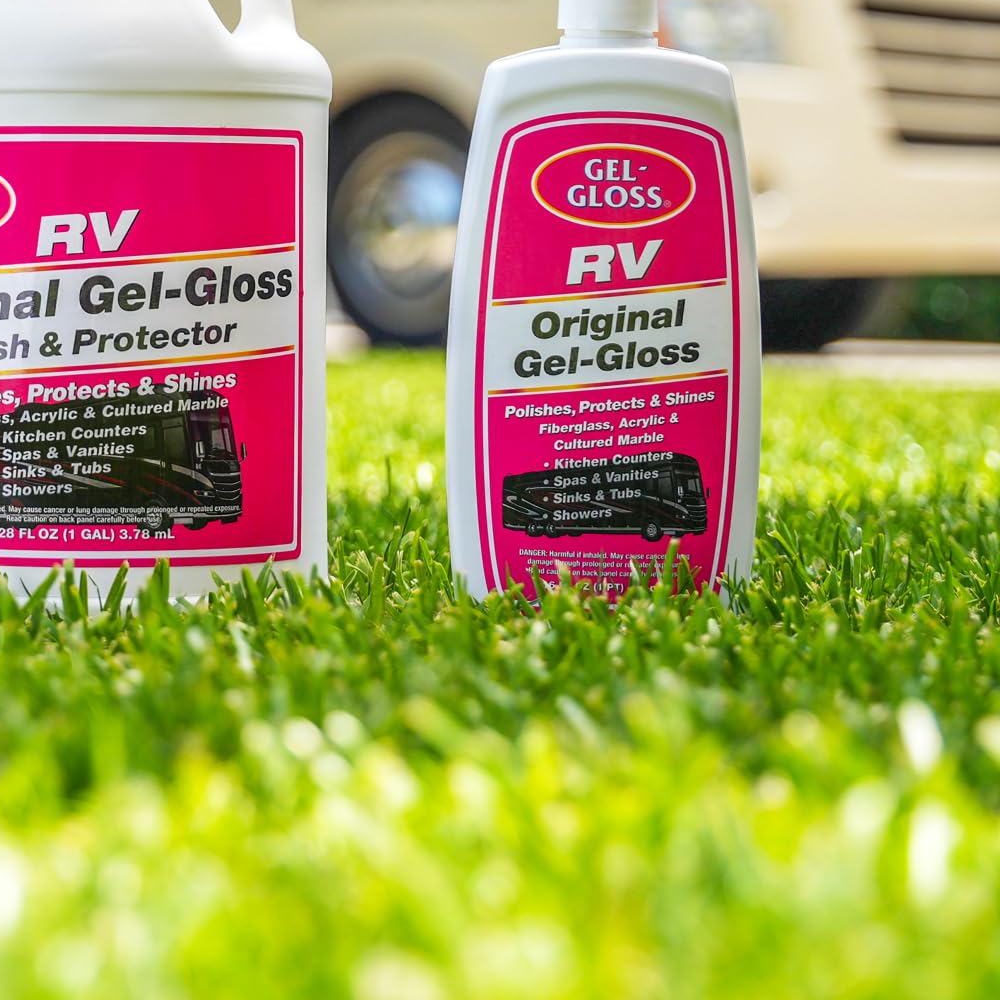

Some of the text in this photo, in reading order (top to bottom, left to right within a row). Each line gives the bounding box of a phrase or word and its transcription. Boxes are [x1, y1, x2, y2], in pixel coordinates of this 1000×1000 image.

[584, 159, 648, 182] GEL-
[35, 209, 141, 257] RV
[566, 239, 664, 286] RV
[79, 265, 293, 315] Gel-Gloss
[531, 299, 686, 341] Original
[39, 331, 63, 357] &
[72, 321, 237, 354] Protector
[514, 341, 700, 378] Gel-Gloss
[27, 379, 130, 404] Protects
[137, 376, 156, 395] &
[163, 371, 237, 393] Shines
[20, 407, 78, 423] Acrylic
[83, 406, 96, 419] &
[102, 401, 173, 418] Cultured
[177, 396, 229, 412] Marble
[505, 390, 715, 418] Polishes, Protects & Shines
[539, 412, 679, 435] Fiberglass, Acrylic &
[2, 424, 147, 444] Kitchen Counters
[554, 432, 664, 451] Cultured Marble
[2, 442, 135, 464] Spas & Vanities
[554, 451, 673, 470] Kitchen Counters
[2, 461, 112, 480] Sinks & Tubs
[553, 469, 659, 489] Spas & Vanities
[2, 482, 73, 497] Showers
[553, 487, 641, 504] Sinks & Tubs
[8, 505, 21, 513] May
[76, 507, 90, 515] lung
[120, 506, 145, 514] through
[146, 505, 178, 513] prolonged
[188, 505, 213, 513] repeated
[214, 504, 241, 512] exposure.
[77, 515, 95, 523] panel
[96, 515, 125, 523] carefully
[127, 515, 147, 523] before
[552, 507, 612, 521] Showers
[19, 528, 35, 539] FL
[39, 528, 58, 539] OZ
[63, 528, 75, 542] (1
[81, 528, 115, 542] GAL)
[119, 528, 150, 539] 3.78
[155, 528, 175, 539] mL
[519, 549, 547, 557] DANGER:
[549, 550, 575, 558] Harmful
[528, 558, 553, 566] damage
[607, 583, 624, 593] PT)
